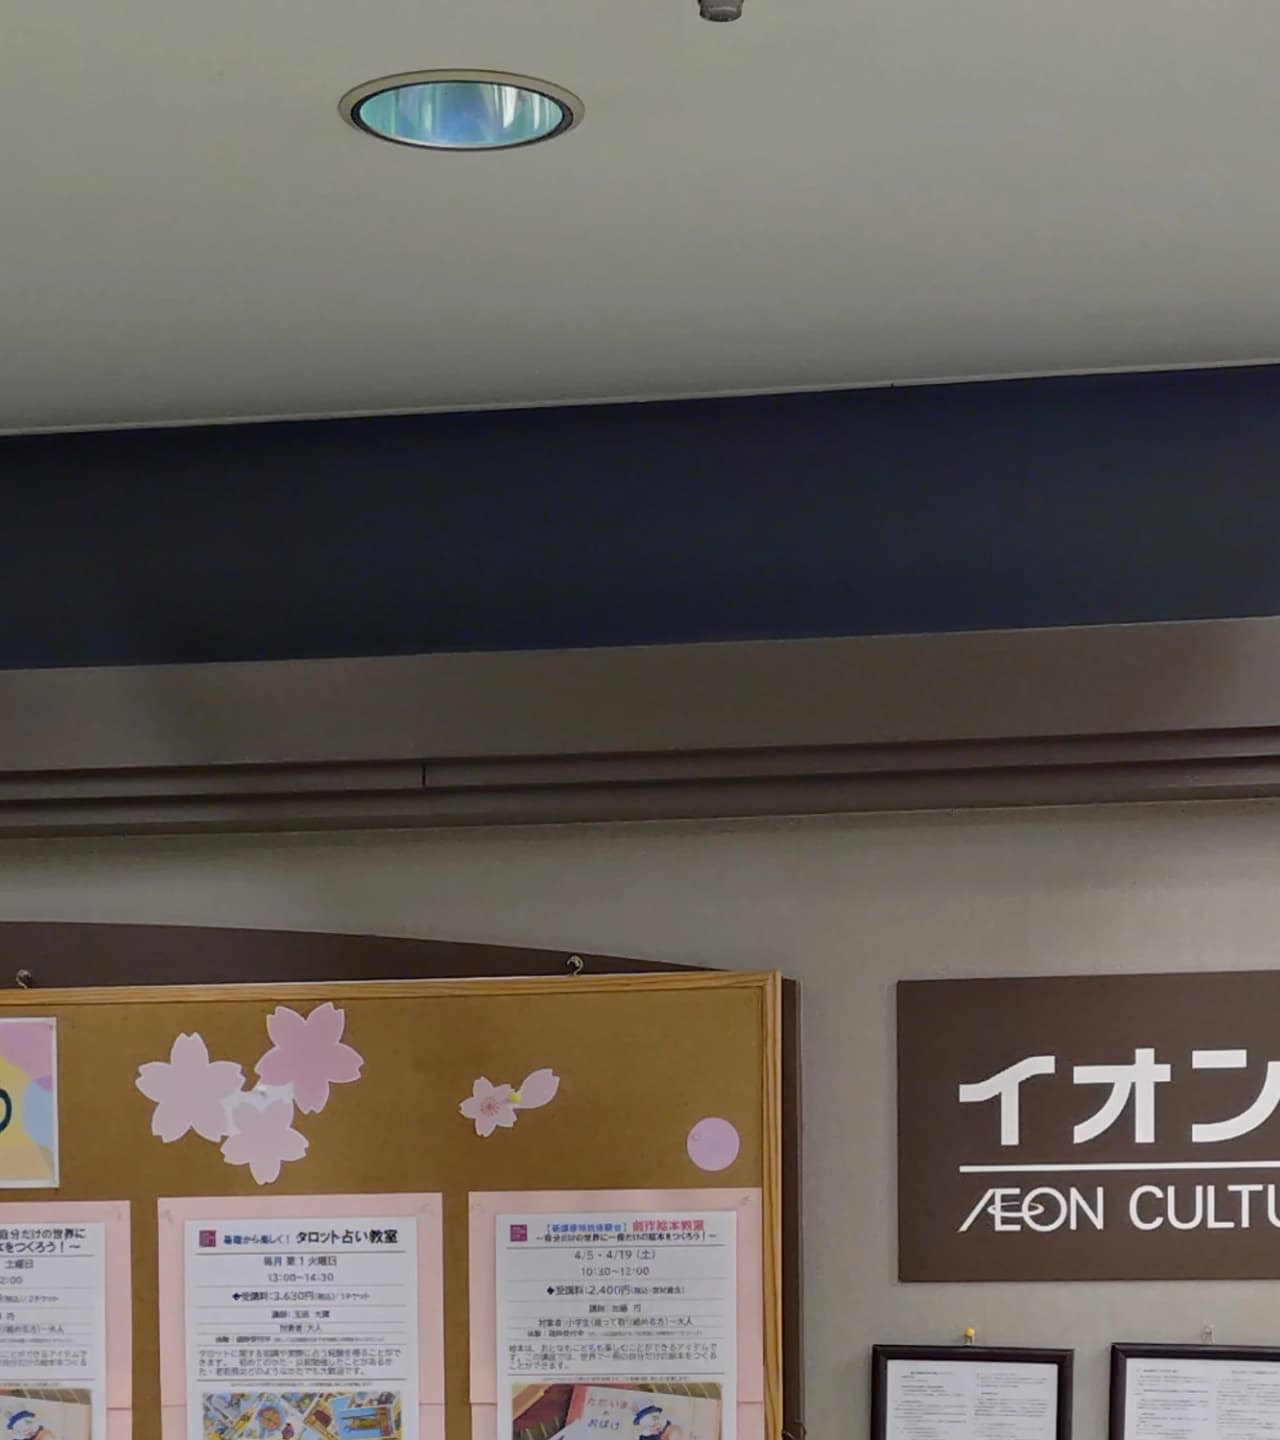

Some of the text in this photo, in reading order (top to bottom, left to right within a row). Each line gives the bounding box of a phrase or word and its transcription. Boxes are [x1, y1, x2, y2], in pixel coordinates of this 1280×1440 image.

[295, 1228, 399, 1245] タロット占い教室
